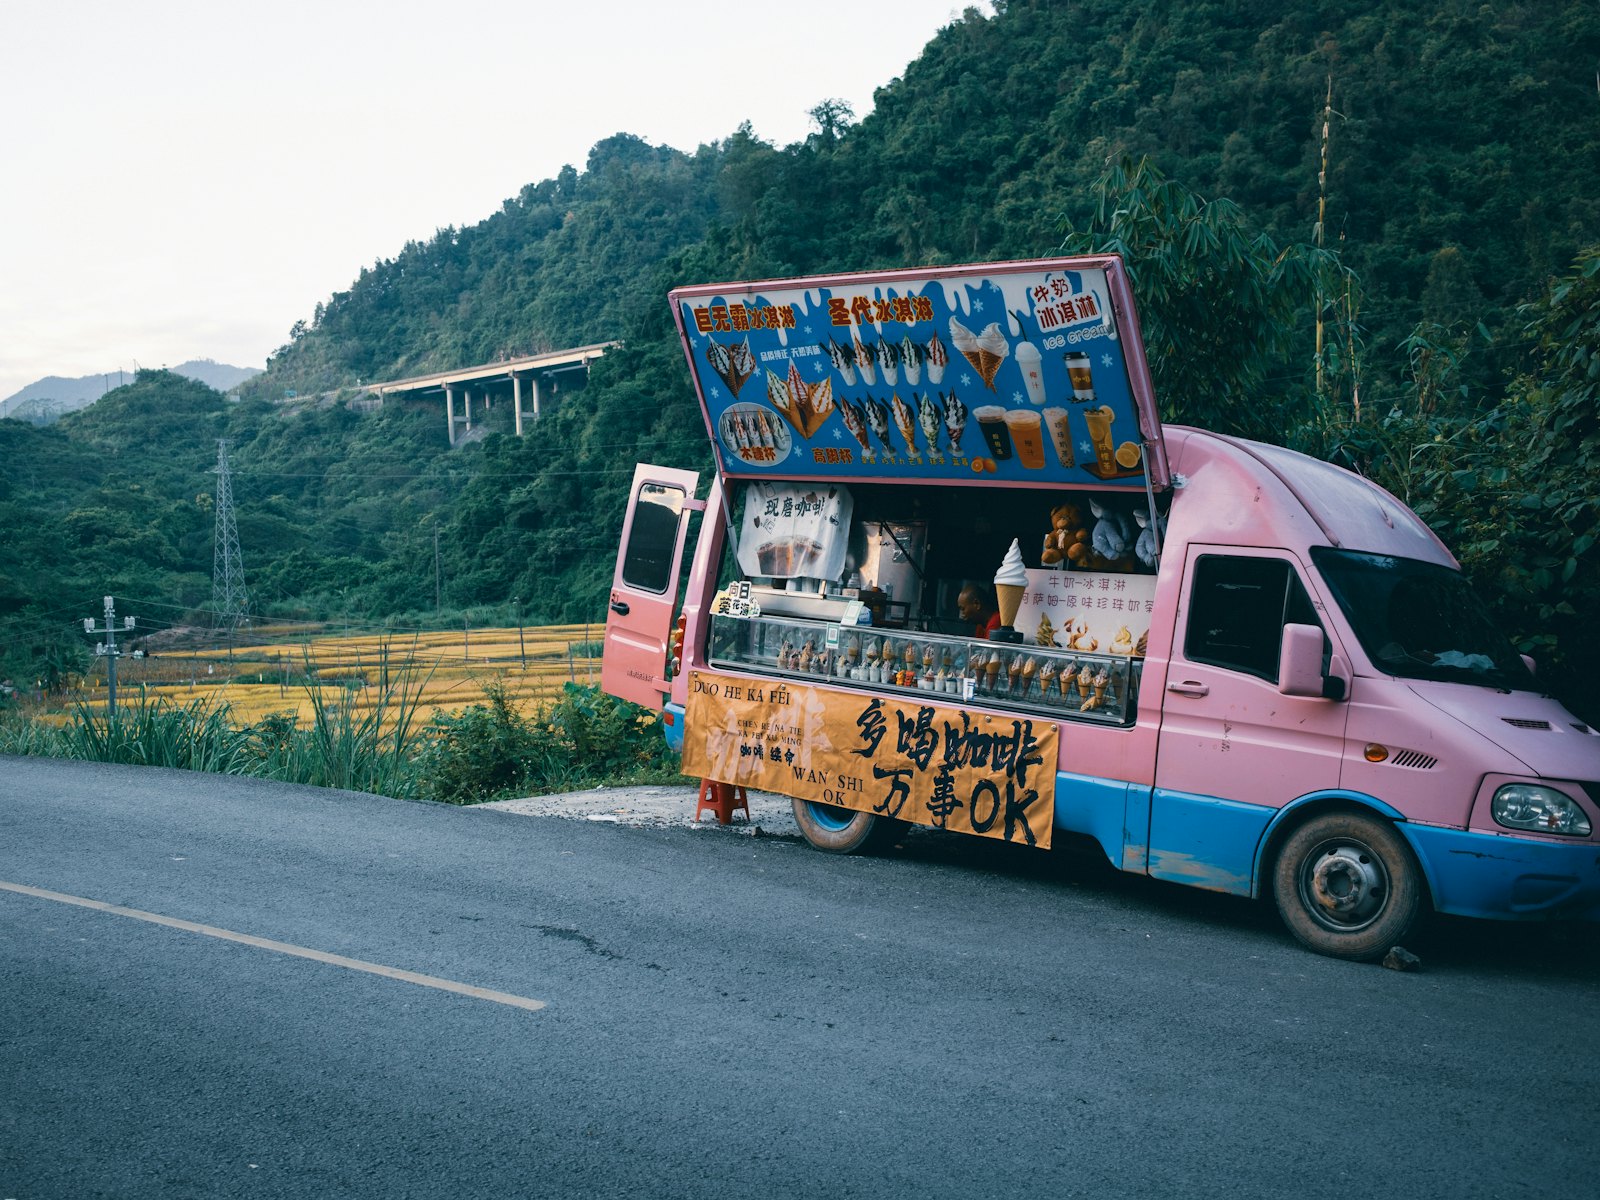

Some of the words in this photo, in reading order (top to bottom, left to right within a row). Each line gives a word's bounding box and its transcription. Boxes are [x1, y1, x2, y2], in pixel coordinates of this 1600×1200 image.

[1033, 278, 1069, 303] 牛奶
[693, 304, 797, 332] 巨无霸冰淇淋
[828, 296, 935, 326] 圣代冰淇淋
[1036, 295, 1098, 329] 冰淇淋
[693, 680, 719, 696] DUO
[723, 685, 742, 700] HE
[747, 687, 763, 703] KA
[769, 690, 791, 706] FEI
[774, 723, 785, 733] NA
[789, 726, 802, 736] TIE
[851, 698, 1044, 789] 多喝咖啡
[793, 766, 828, 785] WAN
[838, 774, 864, 793] SHI
[823, 788, 846, 806] OK
